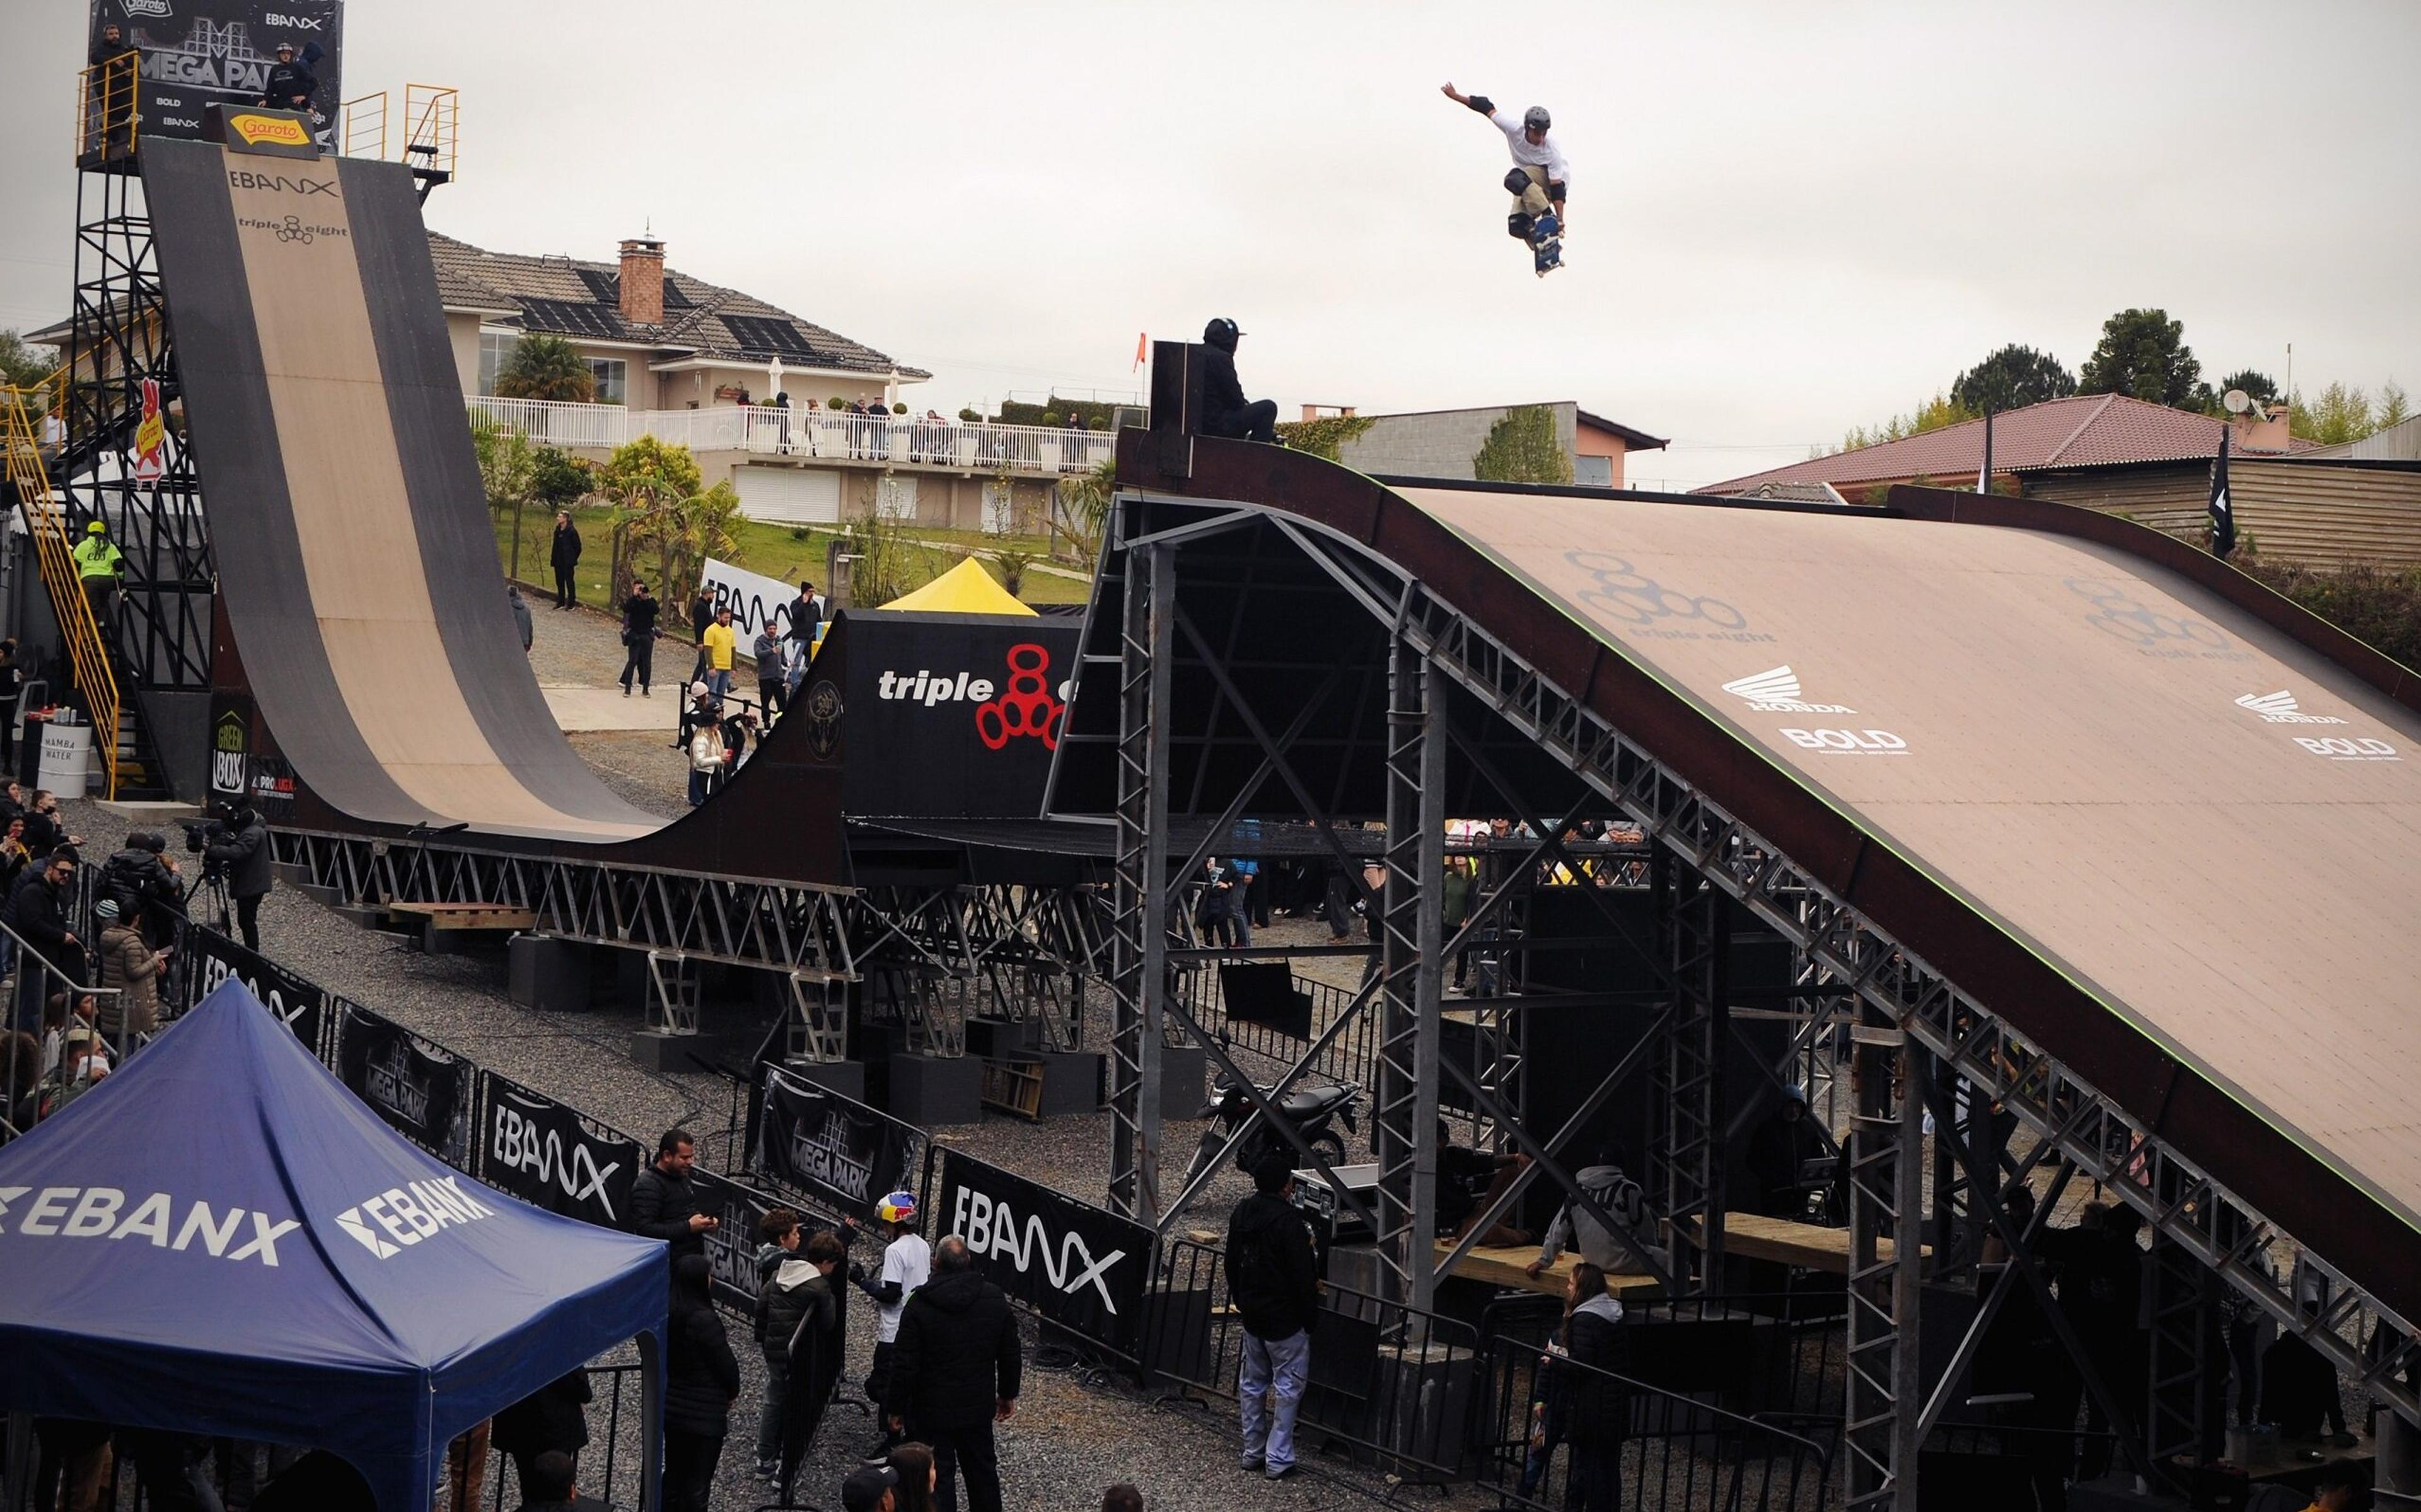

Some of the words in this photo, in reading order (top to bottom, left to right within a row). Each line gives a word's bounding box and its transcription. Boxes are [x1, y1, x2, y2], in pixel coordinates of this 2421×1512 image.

[266, 13, 322, 31] EBANX
[138, 52, 221, 87] MEGA
[156, 97, 181, 107] BOLD
[163, 117, 199, 129] EBANX
[243, 118, 297, 137] Garoto
[229, 171, 339, 197] EBANX
[238, 218, 281, 229] triple
[305, 225, 348, 236] eight
[1629, 628, 1700, 640] triple
[1707, 632, 1778, 643] eight
[878, 670, 994, 707] triple
[1745, 702, 1859, 714] HONDA
[2256, 714, 2350, 724] HONDA
[45, 738, 75, 749] MAMBA
[218, 725, 243, 751] GREEN
[1778, 729, 1907, 749] BOLD
[2292, 737, 2396, 756] BOLD
[46, 750, 72, 760] WATER
[217, 751, 242, 788] BOX
[366, 1066, 398, 1109] MEGA
[400, 1083, 428, 1127] PARK
[494, 1104, 620, 1221] EBANX
[791, 1138, 831, 1184] MEGA
[832, 1151, 872, 1201] PARK
[361, 1175, 496, 1245] EBANX
[20, 1187, 301, 1267] EBANX
[704, 1239, 735, 1284] EGA
[953, 1185, 1127, 1315] EBANX
